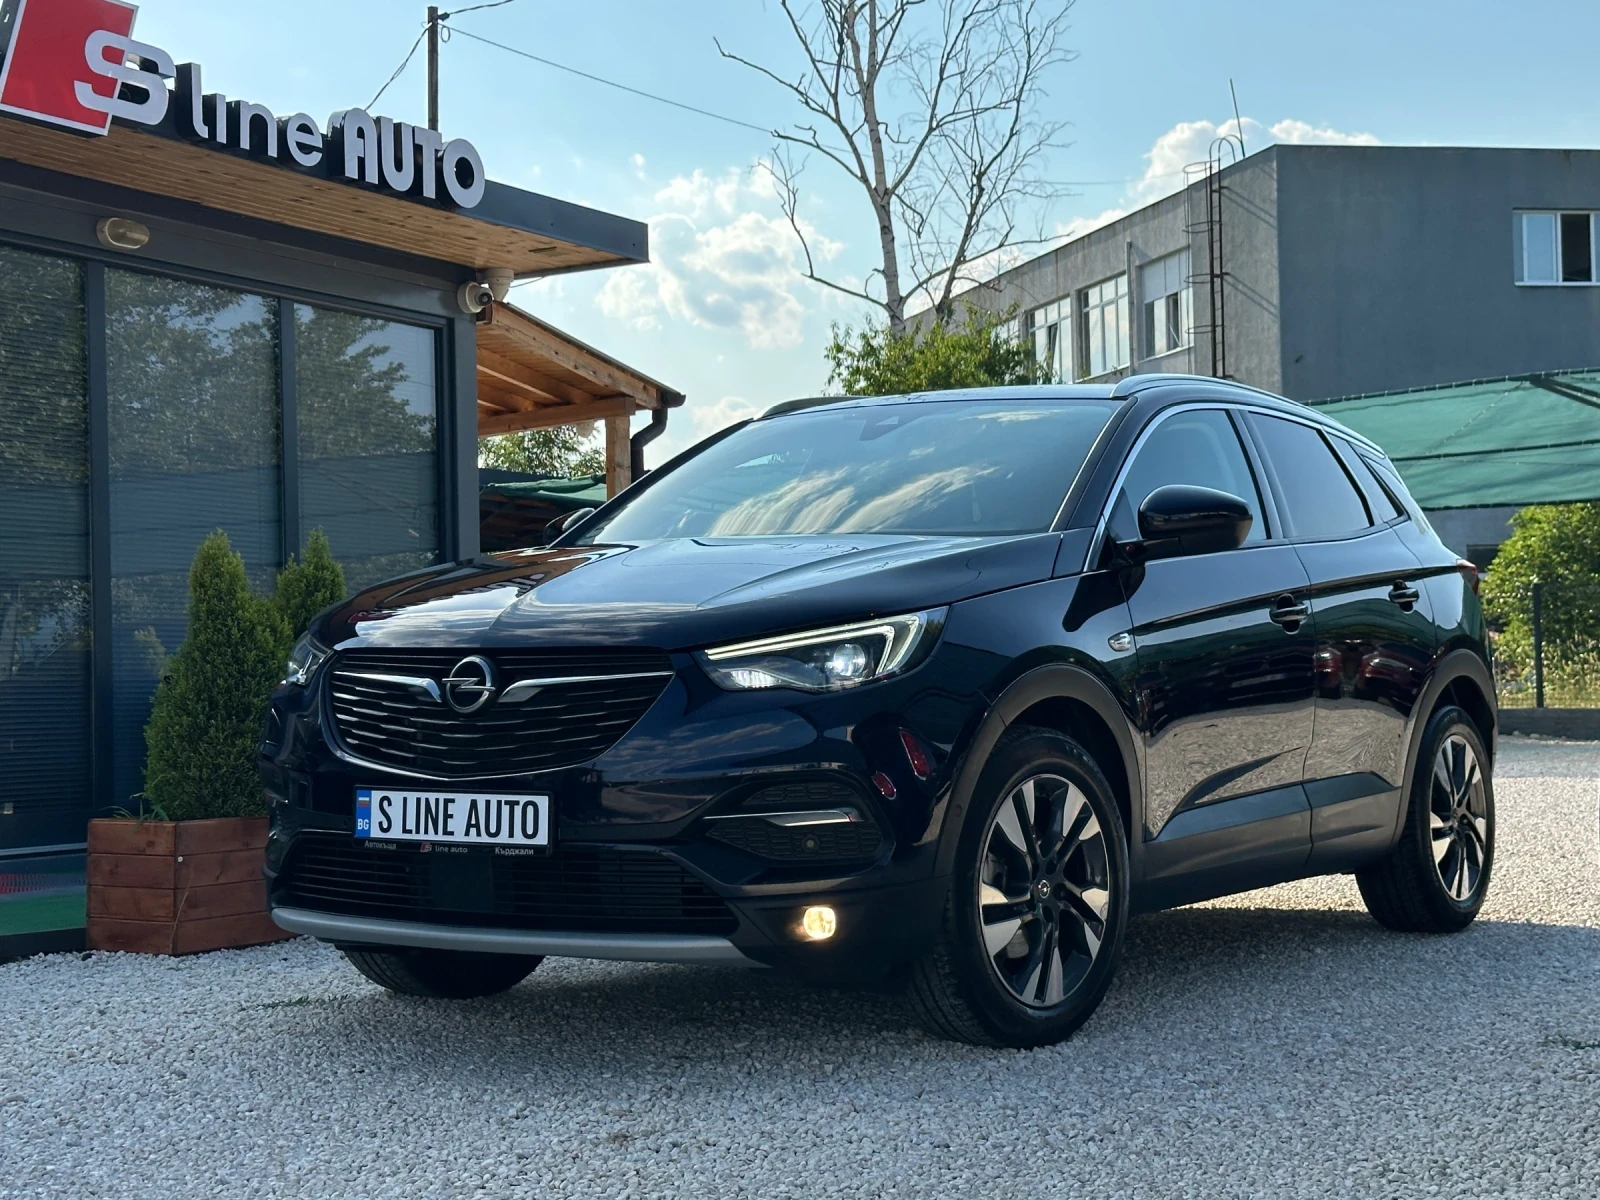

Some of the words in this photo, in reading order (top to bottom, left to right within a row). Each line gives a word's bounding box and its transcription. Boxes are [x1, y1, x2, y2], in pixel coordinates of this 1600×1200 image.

[74, 29, 176, 126] S
[343, 107, 486, 209] AUTO
[378, 795, 393, 834] S
[401, 796, 456, 837] LINE
[464, 798, 540, 840] AUTO
[357, 818, 370, 830] BG
[364, 840, 397, 850] Автокъща
[494, 846, 534, 856] Кърджали
